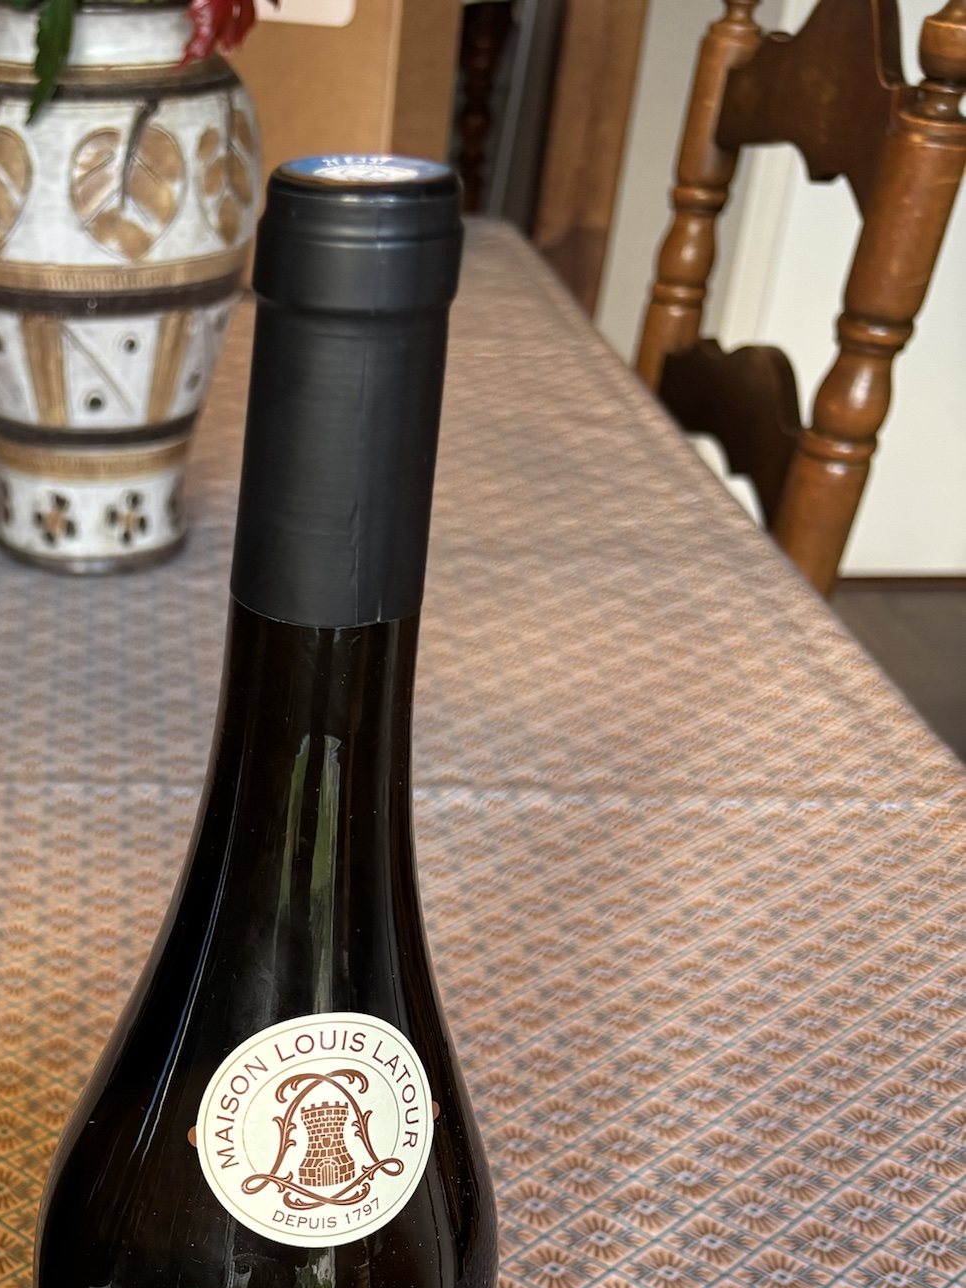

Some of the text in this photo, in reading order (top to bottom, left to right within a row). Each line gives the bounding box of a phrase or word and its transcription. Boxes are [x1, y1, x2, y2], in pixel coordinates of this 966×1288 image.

[215, 1030, 419, 1169] MAISON LOUIS LATOUR
[272, 1197, 381, 1230] DEPUIS 1797
